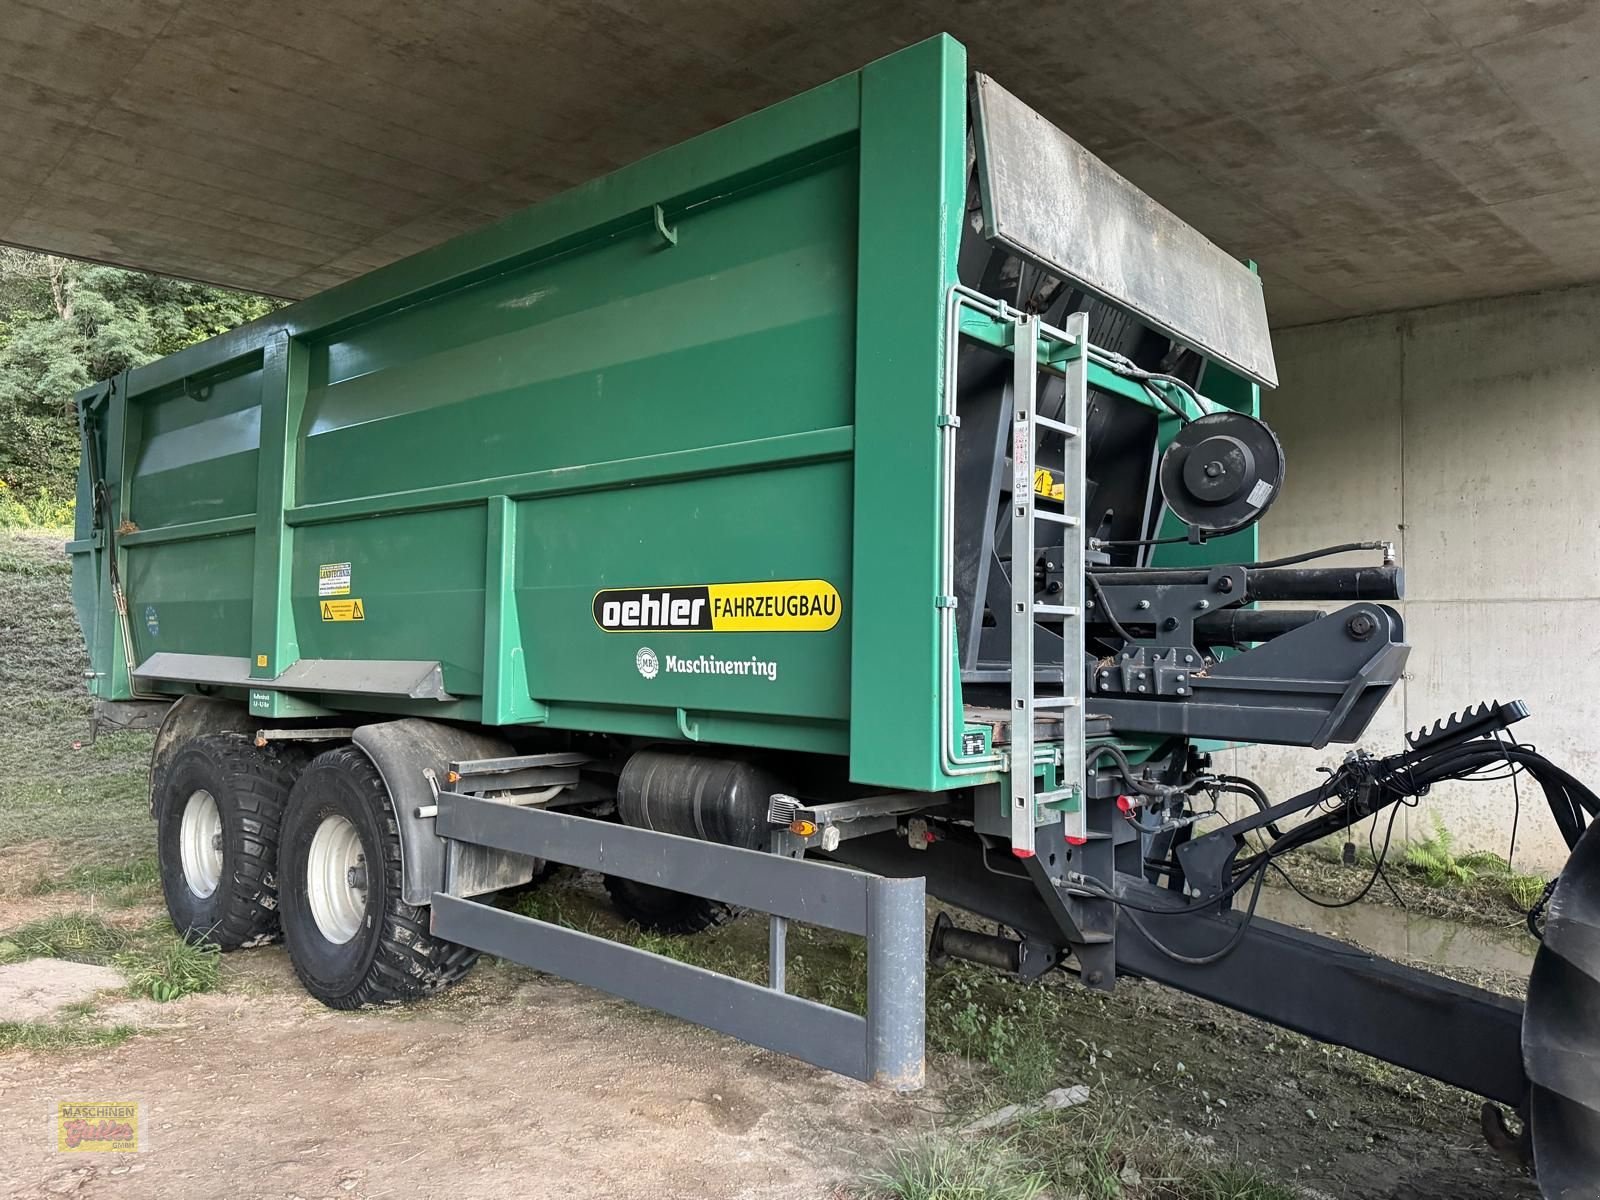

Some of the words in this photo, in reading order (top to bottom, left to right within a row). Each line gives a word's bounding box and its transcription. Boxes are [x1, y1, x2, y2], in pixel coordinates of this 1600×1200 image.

[602, 592, 706, 627] oehler
[714, 594, 836, 618] FAHRZEUGBAU
[665, 655, 777, 681] Maschinenring
